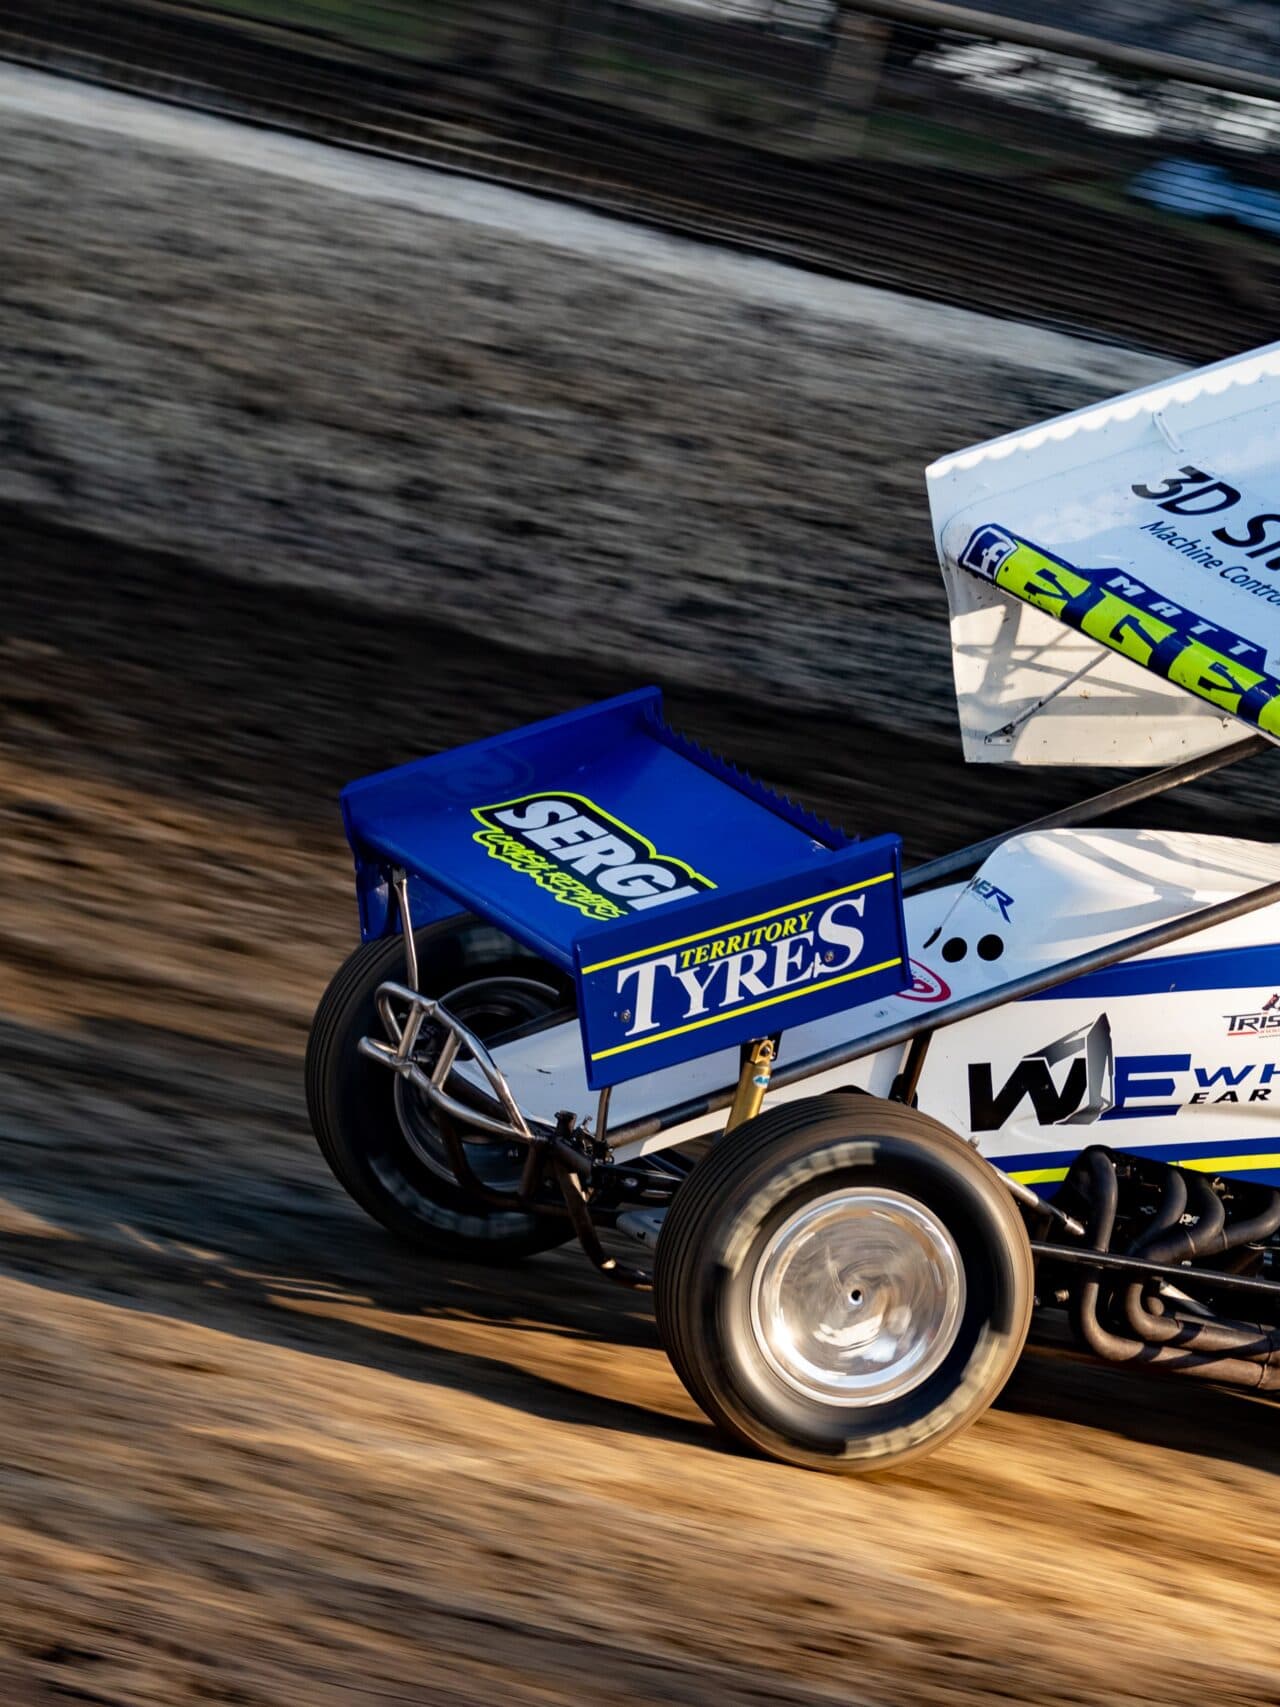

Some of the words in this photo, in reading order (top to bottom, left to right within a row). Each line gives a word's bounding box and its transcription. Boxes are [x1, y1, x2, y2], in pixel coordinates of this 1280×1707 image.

[1131, 465, 1241, 516] 3D
[1140, 520, 1224, 570] Machine
[1105, 575, 1262, 657] MATT
[493, 800, 699, 911] SERGI
[616, 894, 866, 1037] TYRES
[679, 911, 815, 969] TERRITORY
